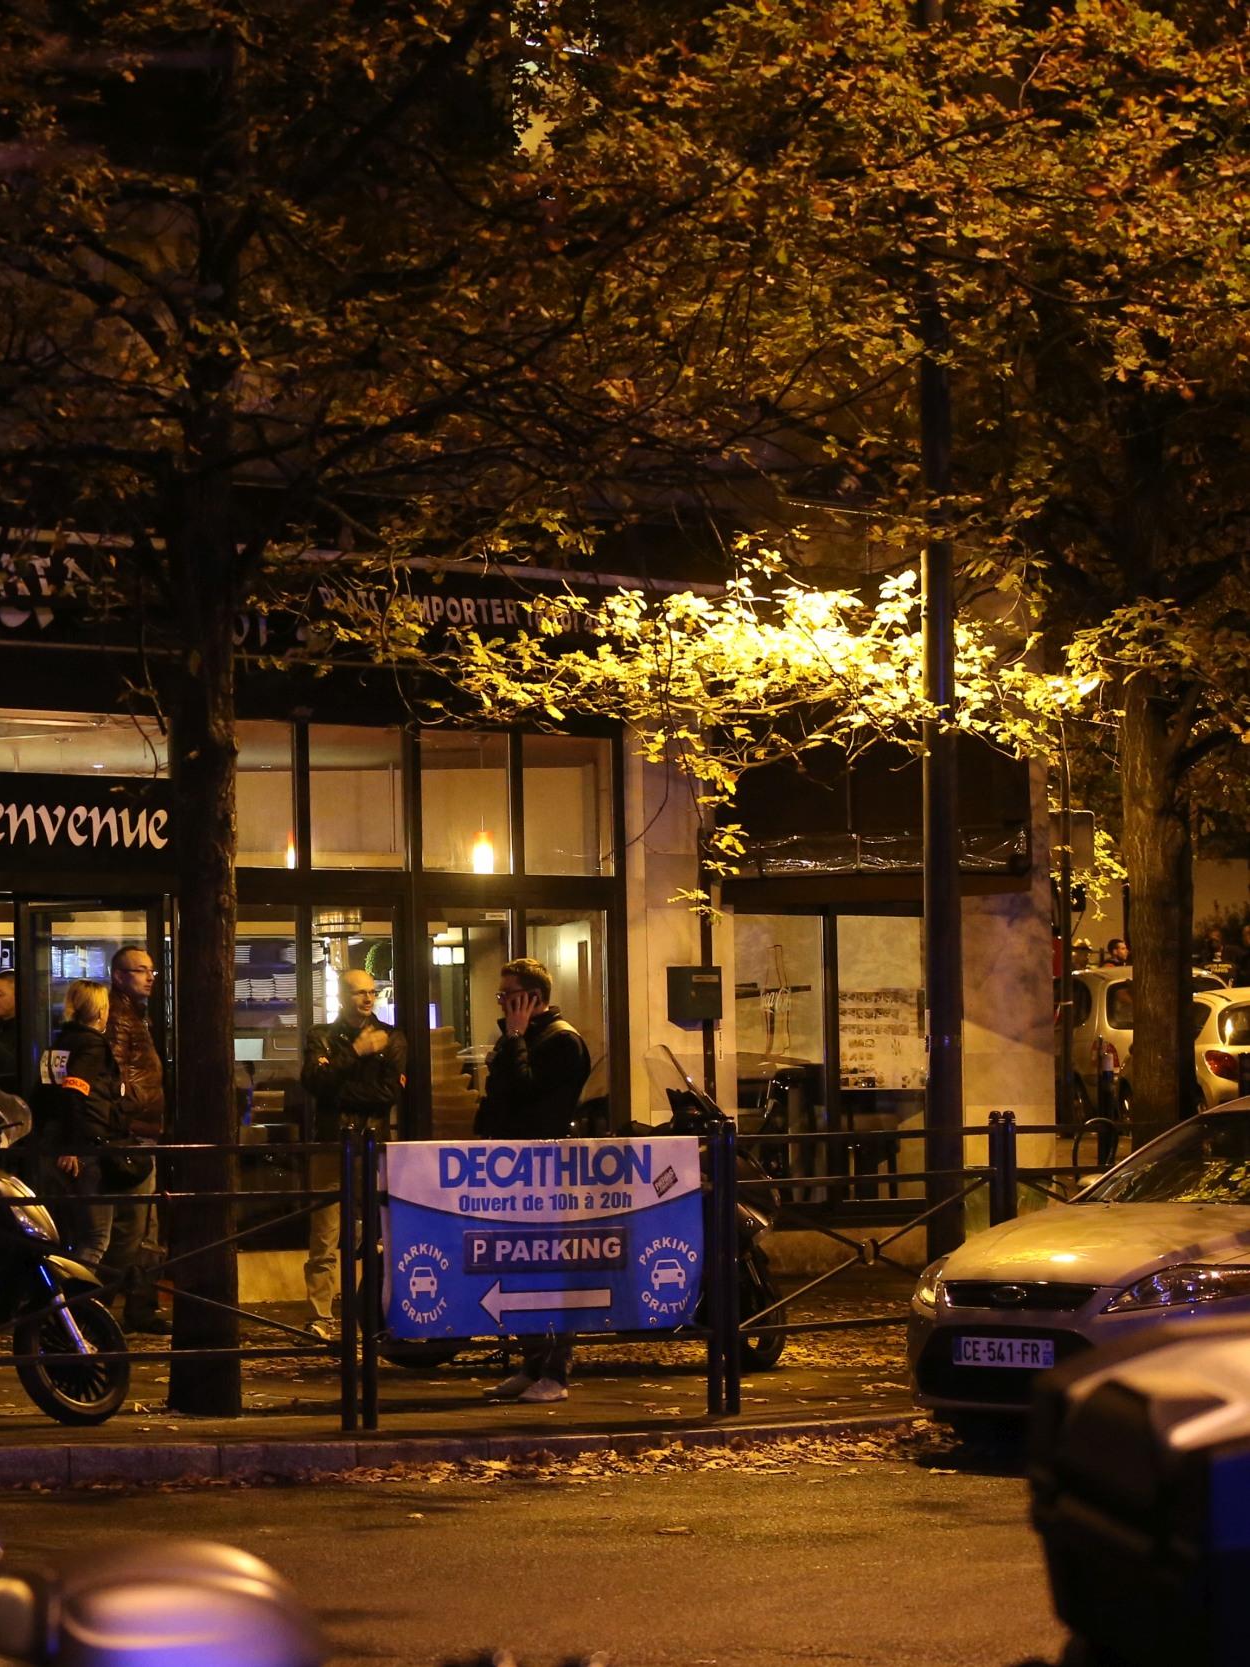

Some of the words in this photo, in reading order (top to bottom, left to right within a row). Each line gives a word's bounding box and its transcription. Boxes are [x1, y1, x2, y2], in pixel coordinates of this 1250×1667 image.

[402, 593, 519, 625] MPORTER
[438, 1144, 652, 1189] DECATHLON
[458, 1195, 517, 1212] Ouvert
[522, 1194, 544, 1211] de
[549, 1193, 579, 1211] 10h
[584, 1191, 595, 1210] à
[600, 1191, 632, 1209] 20h
[398, 1243, 449, 1272] PARKING
[494, 1236, 622, 1262] PARKING
[638, 1236, 698, 1266] PARKING
[402, 1296, 447, 1324] GRATUIT
